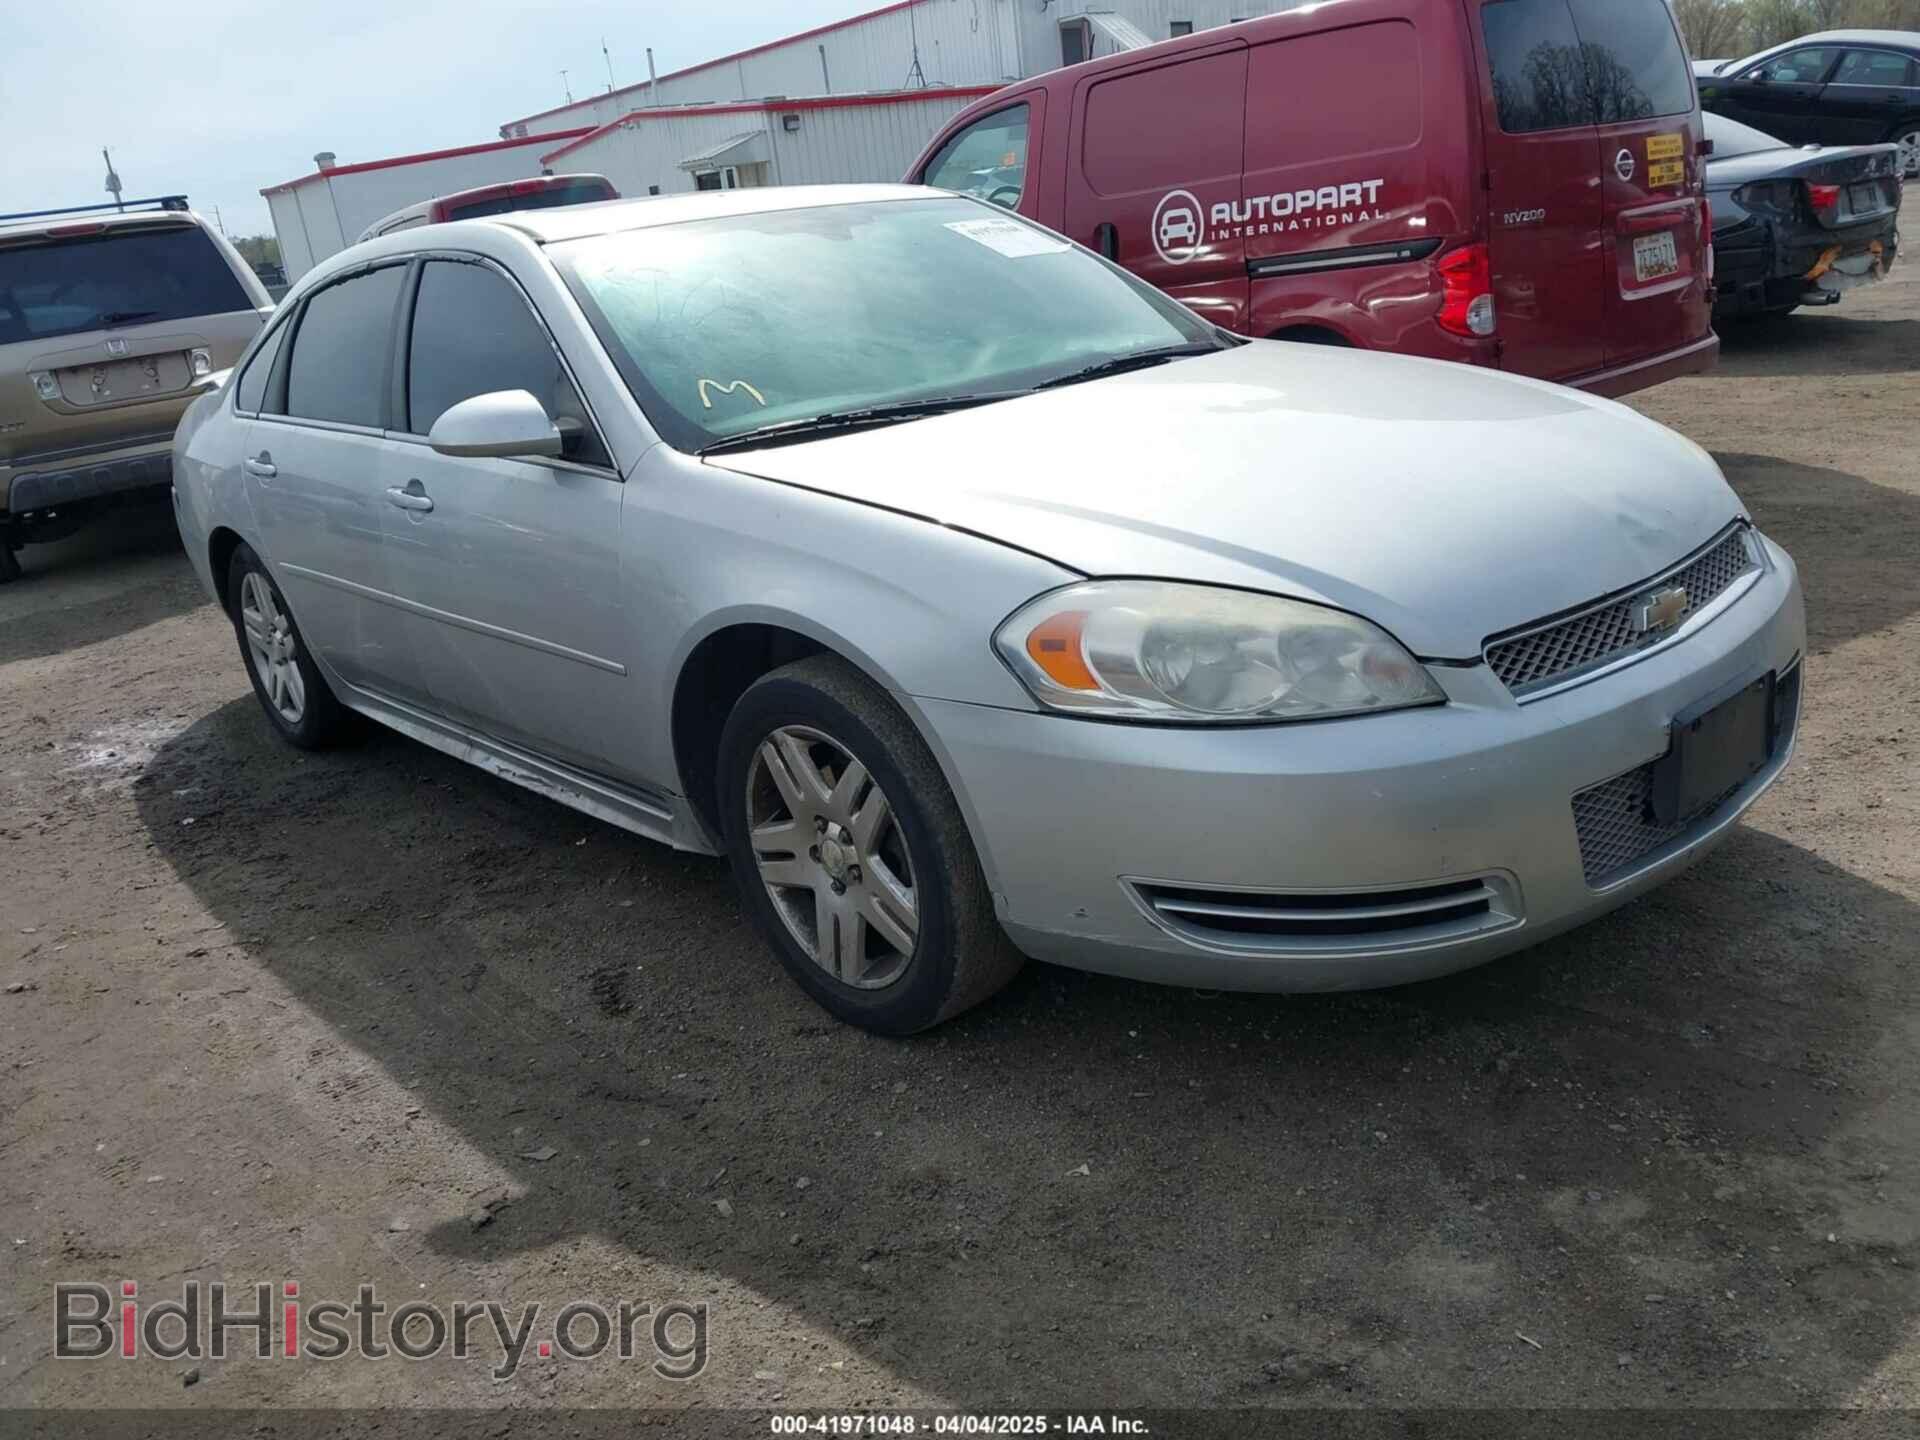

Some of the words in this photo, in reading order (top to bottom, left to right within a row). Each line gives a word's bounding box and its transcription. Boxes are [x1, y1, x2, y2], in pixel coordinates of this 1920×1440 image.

[1211, 179, 1384, 225] AUTOPART
[1504, 208, 1545, 224] NV200
[1211, 208, 1384, 240] INTERNATIONAL
[698, 379, 766, 407] M
